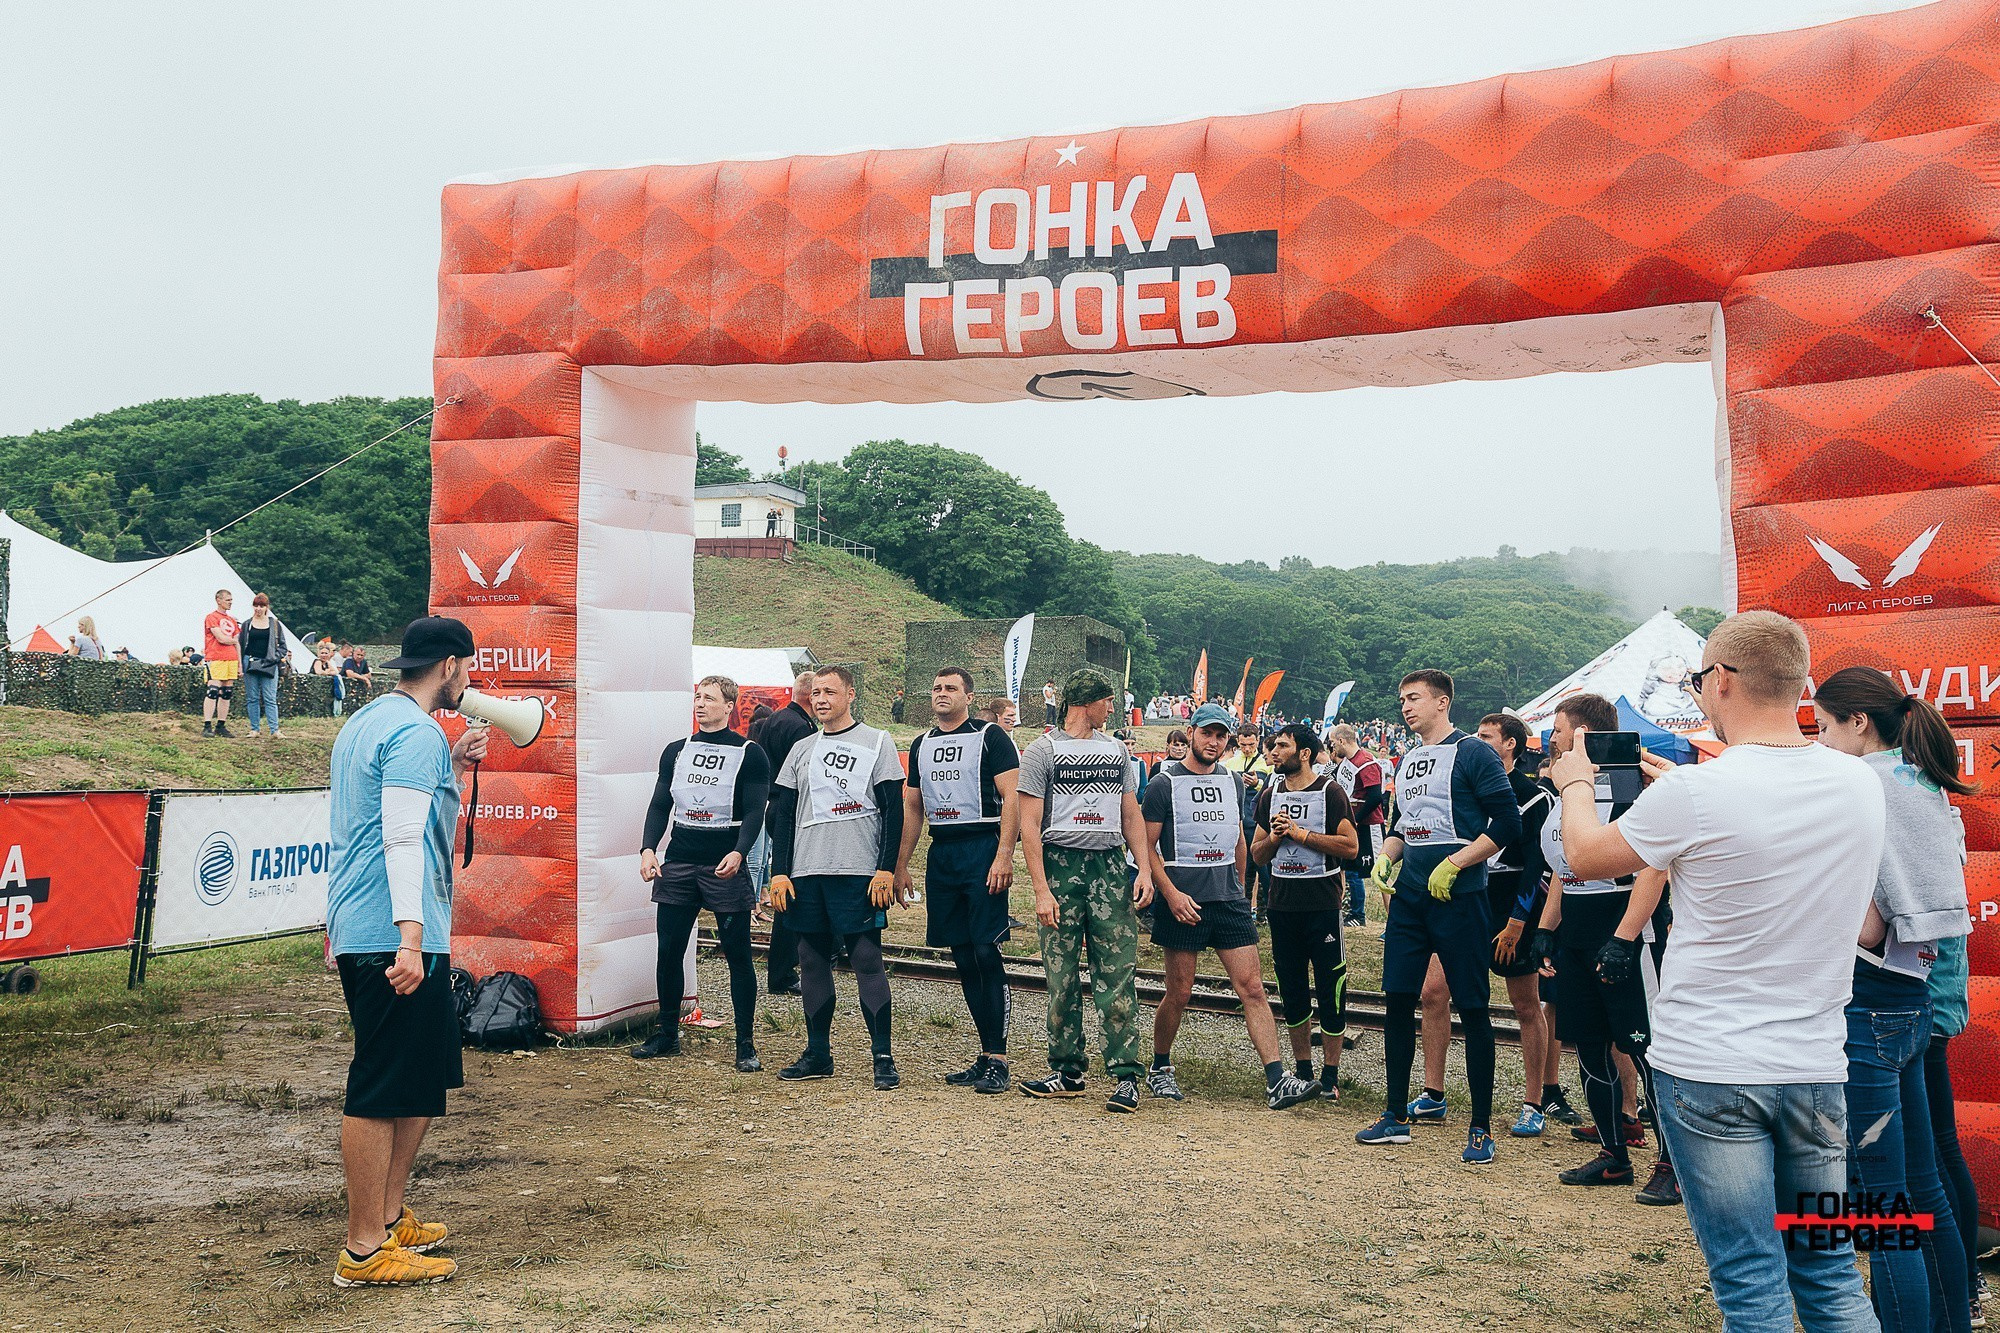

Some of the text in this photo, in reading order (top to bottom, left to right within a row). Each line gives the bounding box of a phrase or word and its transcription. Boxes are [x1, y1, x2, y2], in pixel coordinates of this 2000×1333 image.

[928, 172, 1215, 268] ГОНКА
[904, 263, 1236, 355] ГЕРОЕВ
[489, 594, 520, 602] ГЕРОЕВ
[1826, 594, 1934, 613] ЛИГА ГЕРОЕВ
[692, 753, 726, 770] 091
[823, 751, 858, 772] 091
[933, 746, 963, 763] 091
[931, 769, 960, 782] 0903
[1059, 769, 1120, 779] ИНСТРУКТОР
[1405, 759, 1437, 780] 091
[687, 773, 719, 786] 0902
[1190, 786, 1223, 803] 091
[687, 809, 709, 817] ГОНКА
[1192, 810, 1225, 822] 0905
[1199, 848, 1222, 856] ГОНКА
